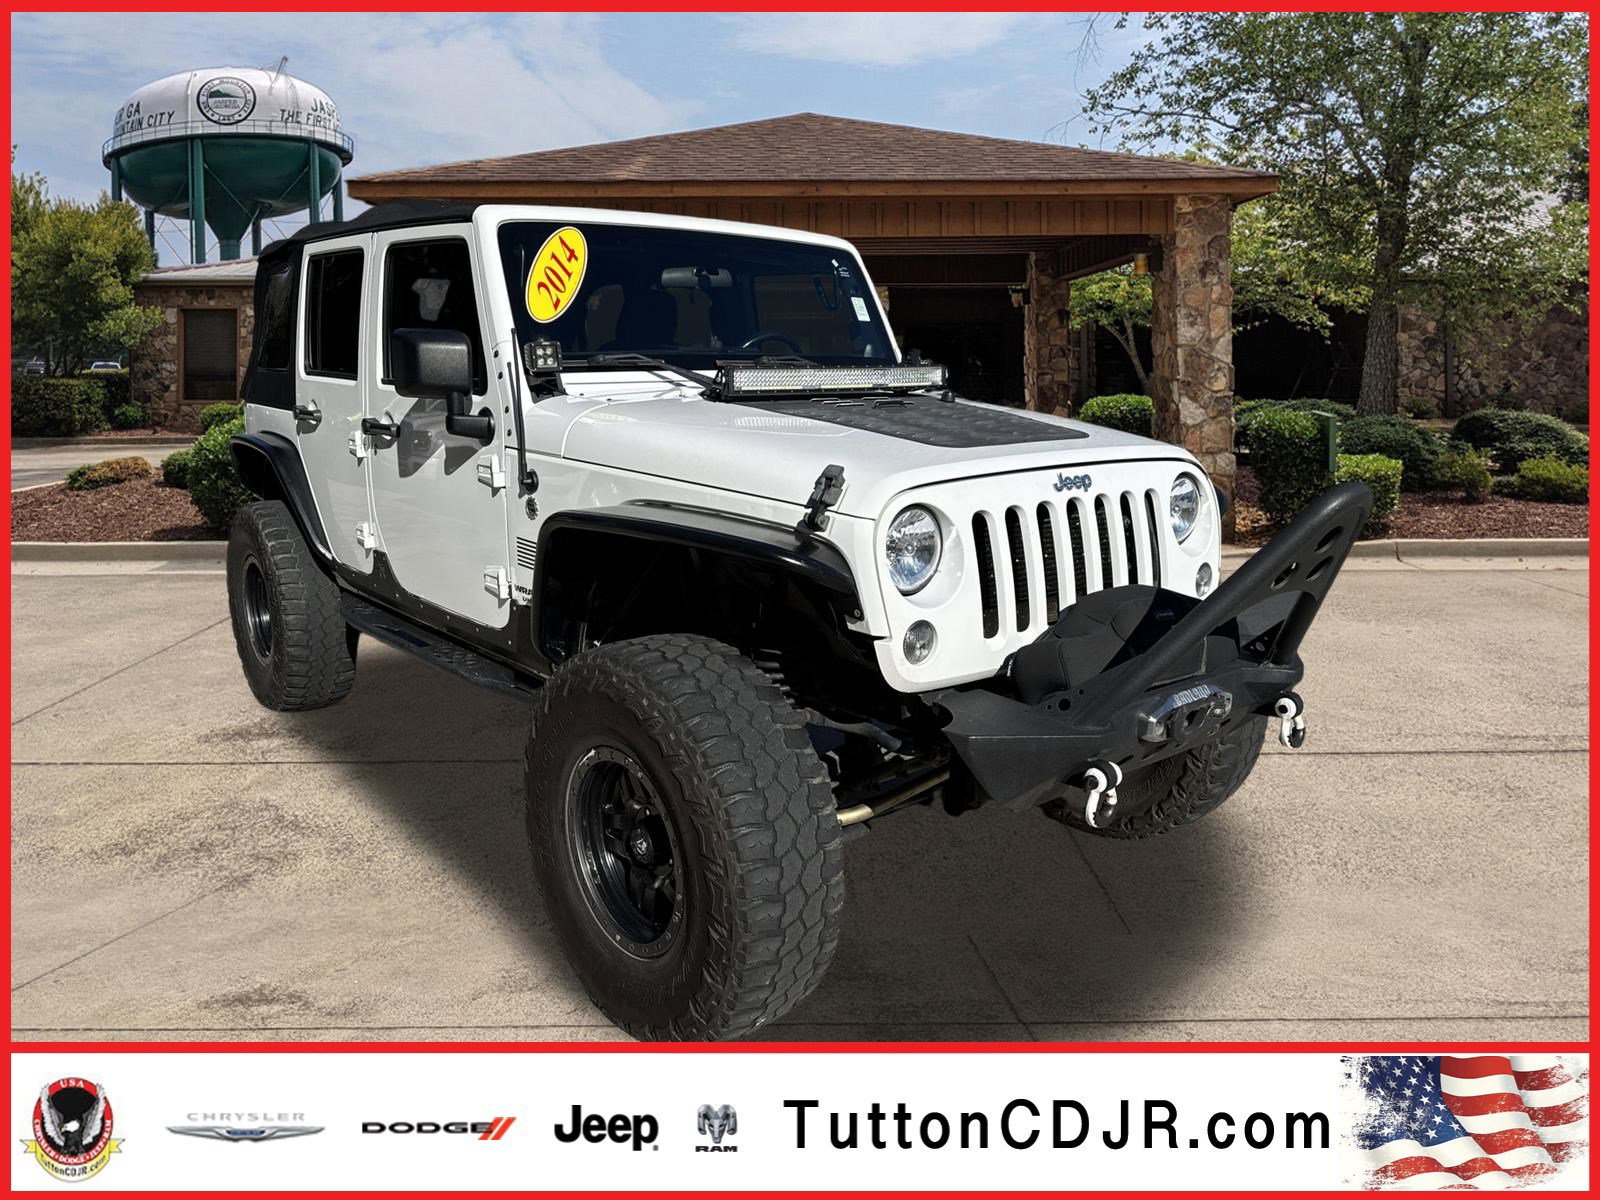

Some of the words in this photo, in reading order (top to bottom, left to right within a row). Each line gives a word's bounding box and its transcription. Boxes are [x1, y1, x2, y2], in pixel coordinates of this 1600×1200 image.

[127, 101, 141, 118] GA
[147, 110, 175, 127] CITY
[280, 109, 302, 124] THE
[306, 113, 332, 129] FIRST
[311, 98, 339, 121] JASP
[537, 235, 579, 311] 2014
[1053, 472, 1092, 492] Jeep
